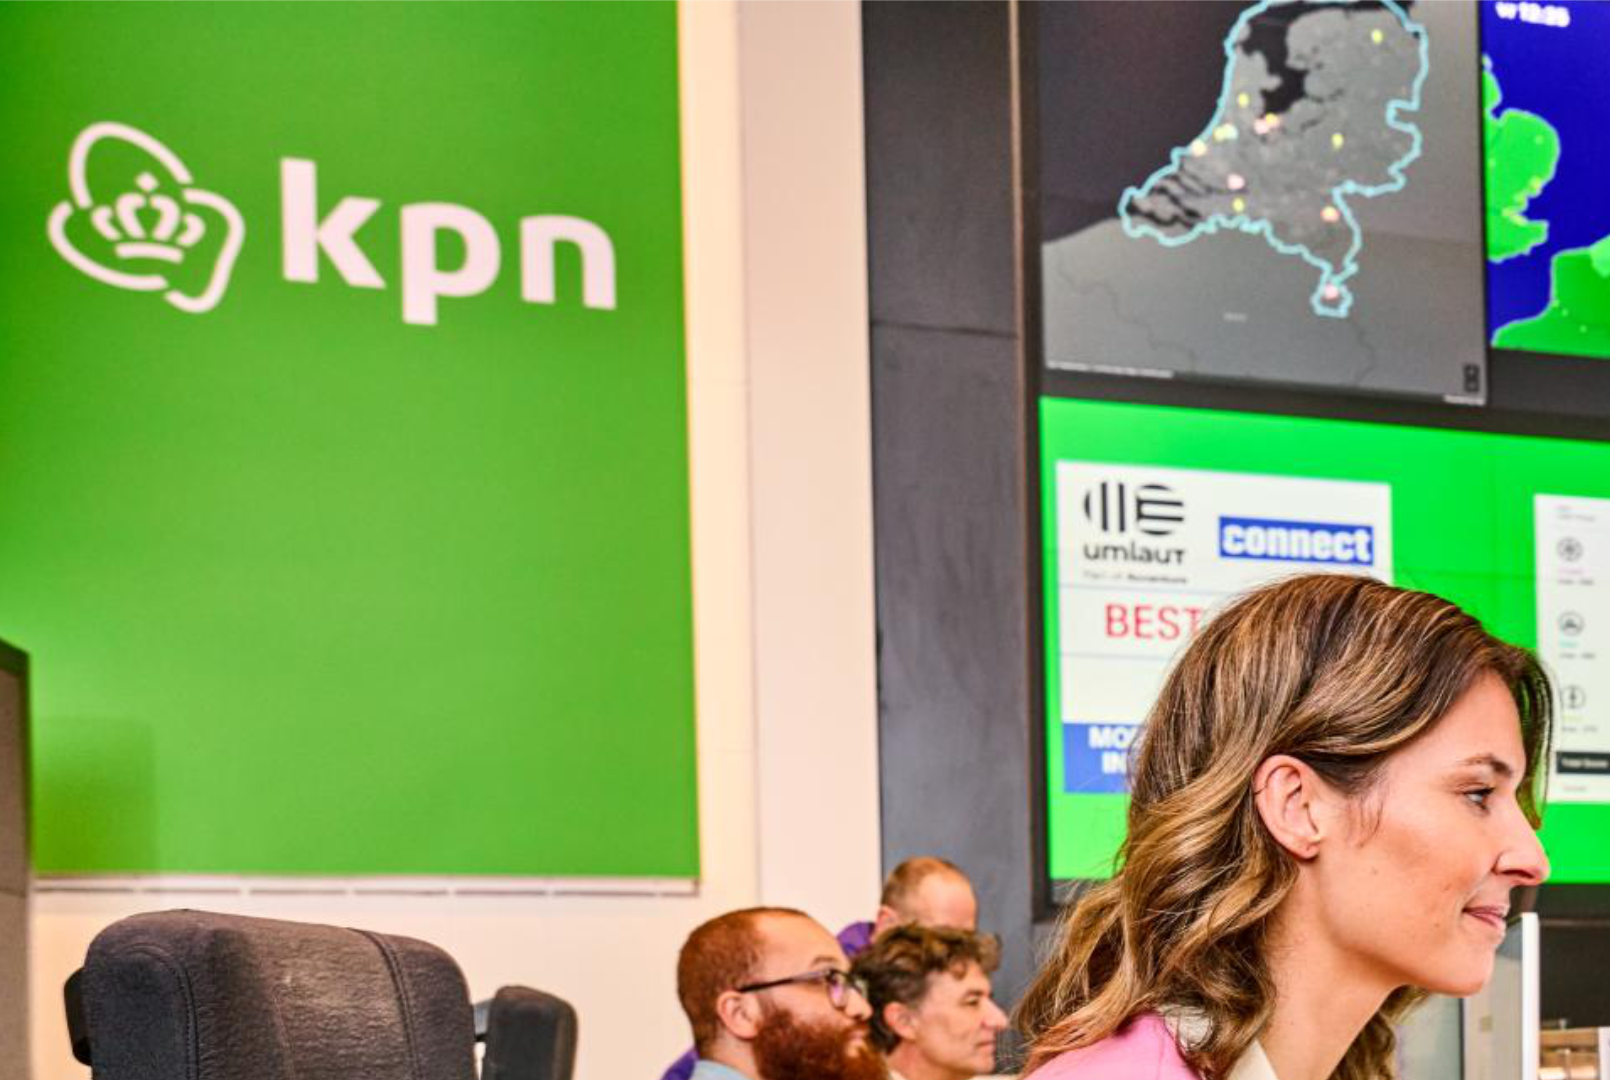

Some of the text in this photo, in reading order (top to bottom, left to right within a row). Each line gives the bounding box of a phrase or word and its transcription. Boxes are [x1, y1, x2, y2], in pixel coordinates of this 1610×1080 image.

[281, 157, 617, 326] kpn
[1222, 523, 1371, 562] connect
[1105, 603, 1204, 640] BEST
